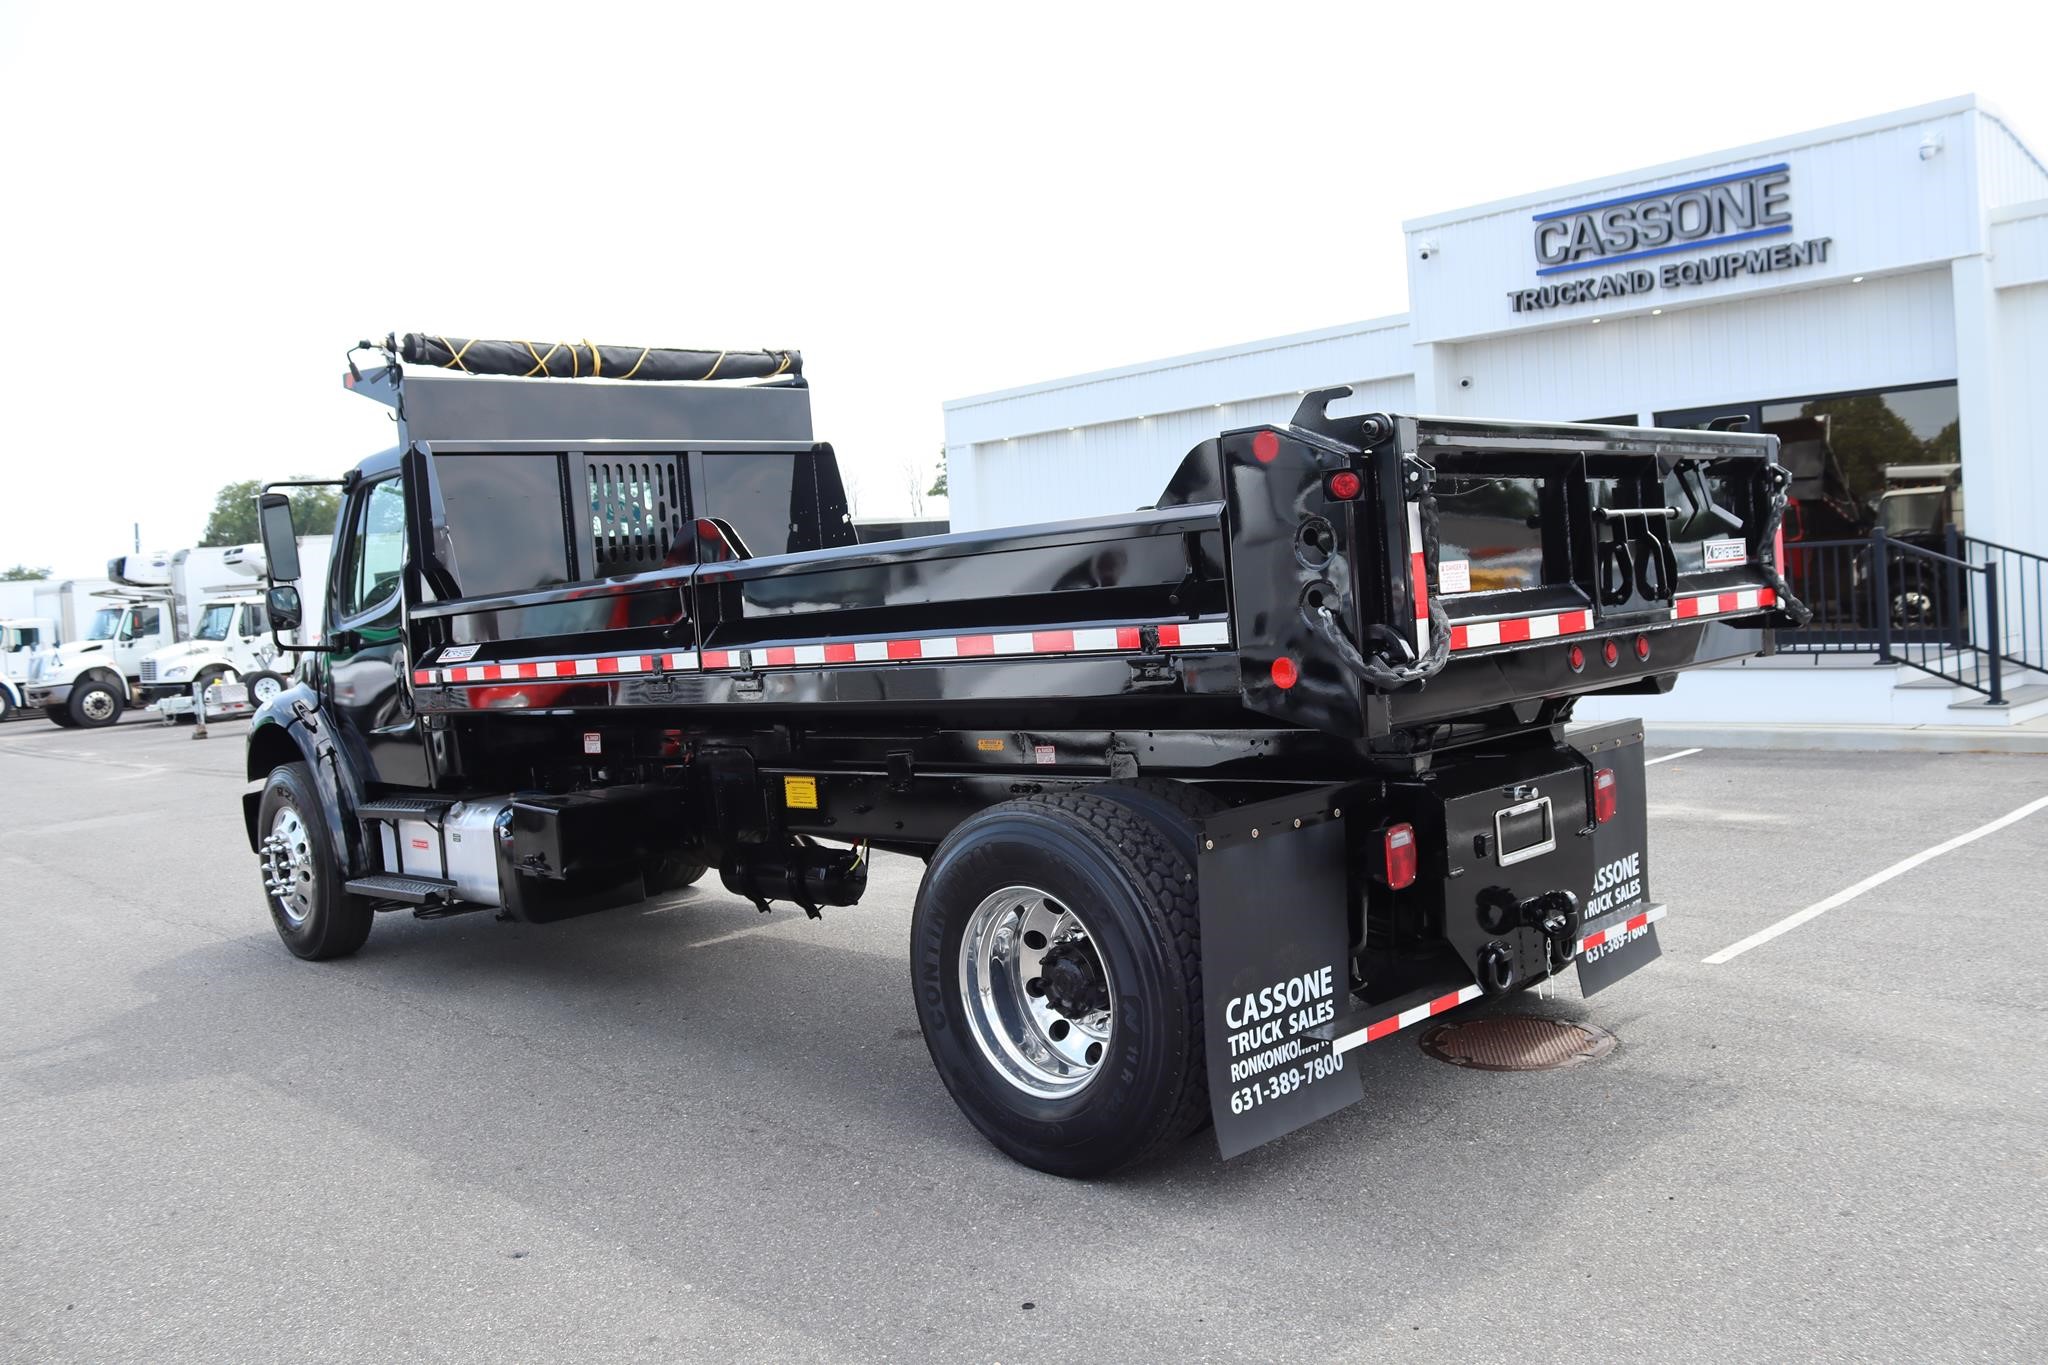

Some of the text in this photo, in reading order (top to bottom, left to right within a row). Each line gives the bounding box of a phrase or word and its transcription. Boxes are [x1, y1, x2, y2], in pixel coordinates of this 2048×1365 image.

[1534, 174, 1792, 265] CASSONE
[1507, 237, 1832, 313] TRUCK AND EQUIPMENT
[1591, 851, 1640, 896] ASSONE
[1614, 878, 1641, 905] SALES
[1226, 966, 1333, 1029] CASSONE
[1227, 999, 1334, 1057] TRUCK SALES
[1230, 1053, 1344, 1115] 631-389-7800
